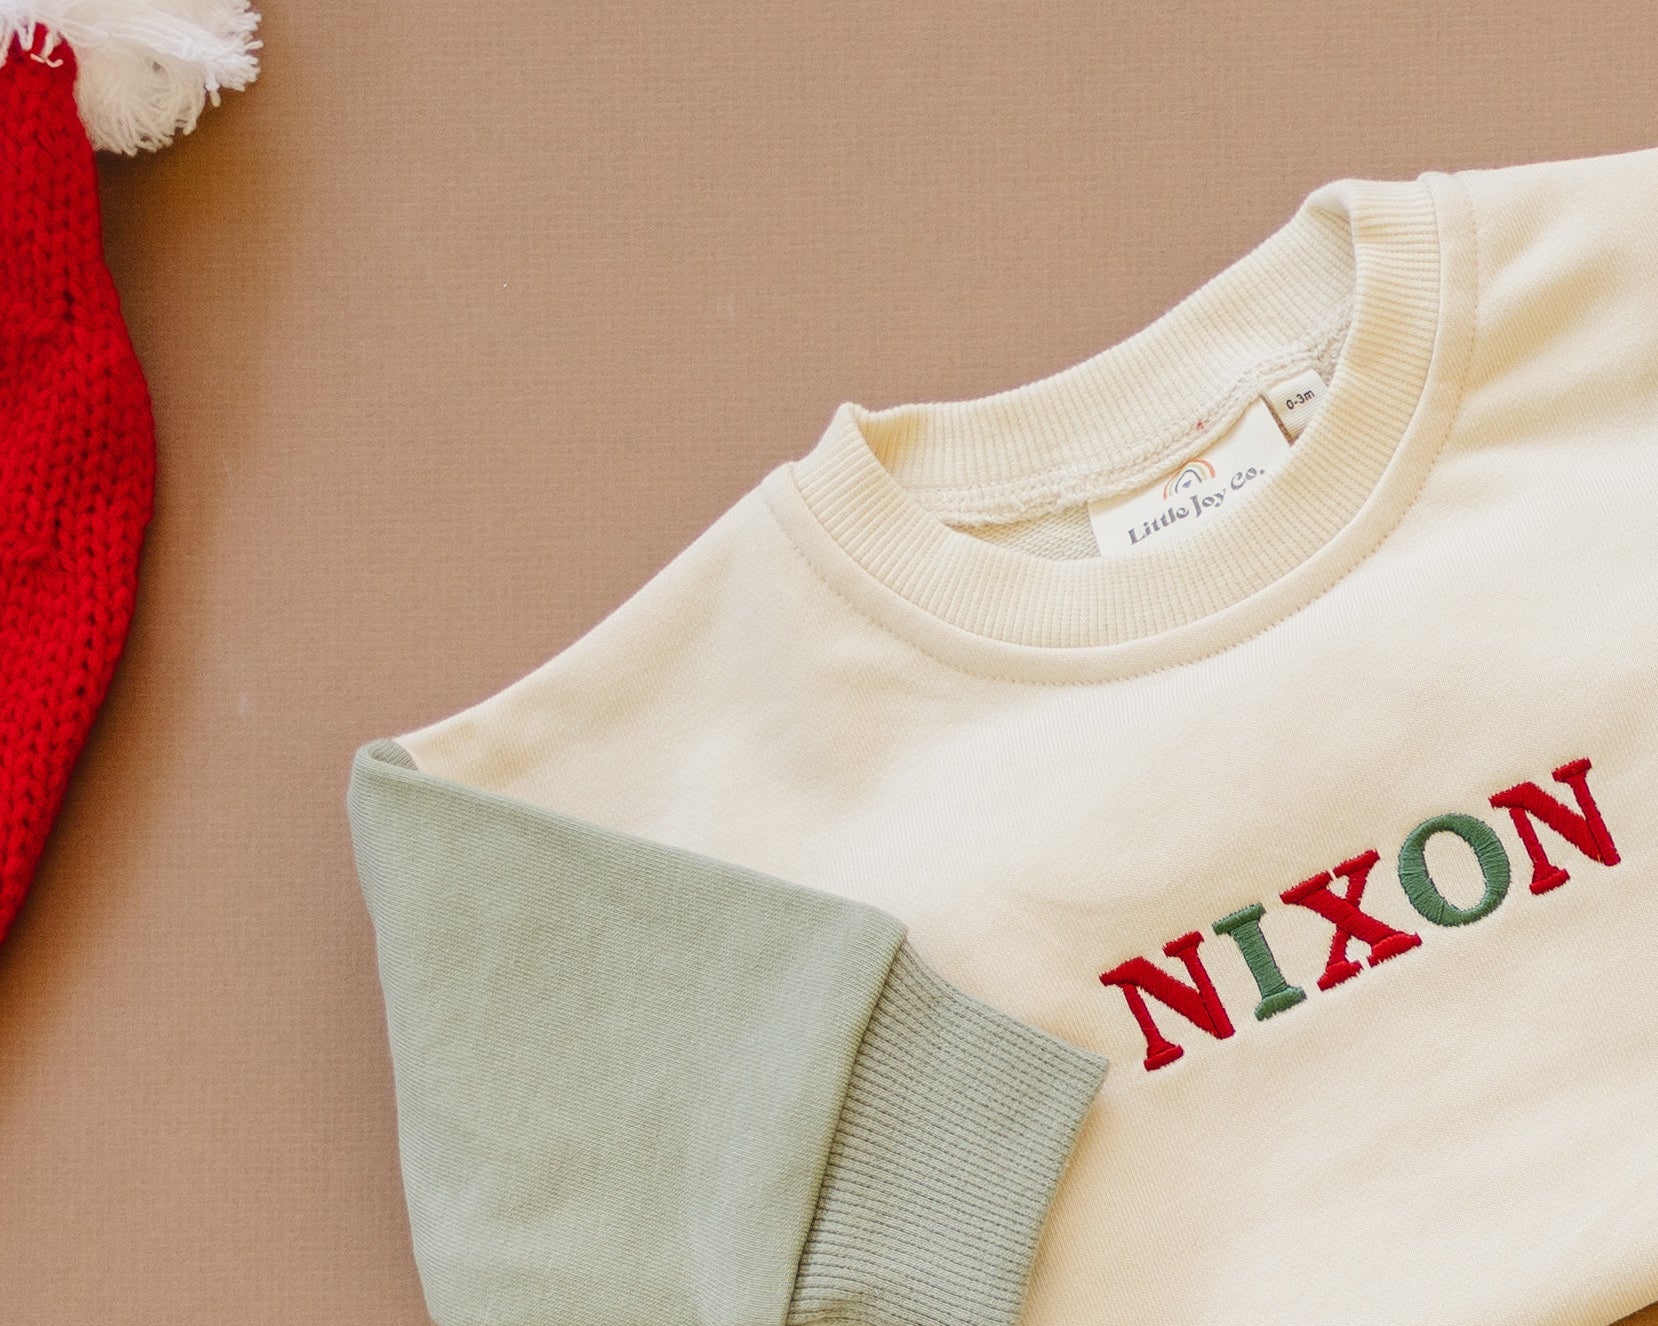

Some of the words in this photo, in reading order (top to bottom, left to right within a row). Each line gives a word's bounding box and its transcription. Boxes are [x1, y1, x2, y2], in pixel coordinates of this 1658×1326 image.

[1285, 388, 1315, 410] 0-3m
[1127, 506, 1190, 545] Little
[1191, 488, 1227, 517] Joy
[1230, 466, 1265, 491] Co.
[1099, 757, 1621, 1072] NIXON
